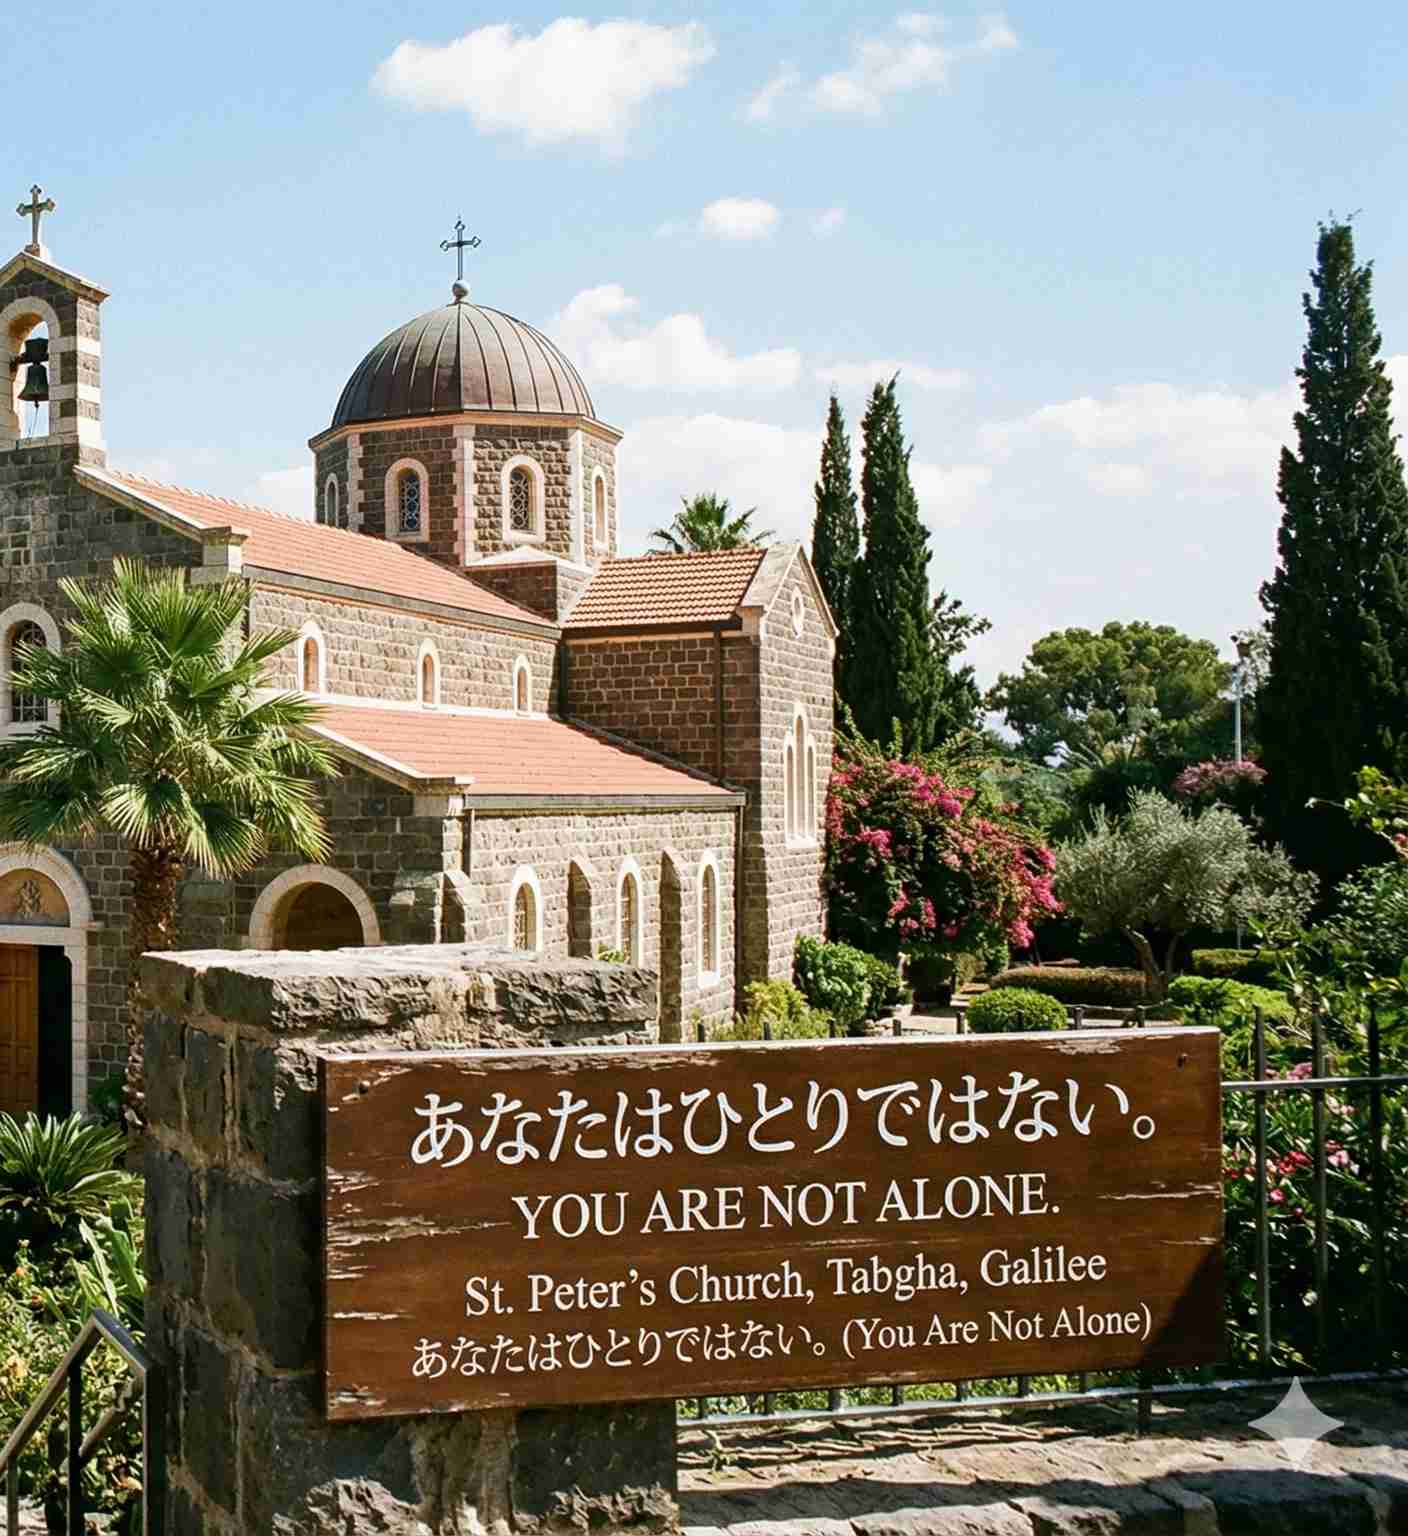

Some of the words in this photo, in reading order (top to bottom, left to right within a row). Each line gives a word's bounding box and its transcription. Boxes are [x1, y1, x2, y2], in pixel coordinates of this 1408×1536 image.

[410, 1070, 1156, 1169] あなたはひとりではない。
[510, 1189, 628, 1239] YOU
[639, 1186, 746, 1234] ARE
[758, 1181, 866, 1229] NOT
[876, 1173, 1062, 1223] ALONE.
[465, 1276, 516, 1317] St.
[527, 1269, 657, 1313] Peter’s
[668, 1260, 815, 1305] Church,
[826, 1253, 970, 1301] Tabgha,
[979, 1245, 1107, 1288] Galilee
[411, 1319, 826, 1379] あなたはひとりではない。
[842, 1318, 917, 1359] (You
[923, 1314, 980, 1347] Are
[988, 1310, 1045, 1342] Not
[1051, 1303, 1153, 1339] Alone)
